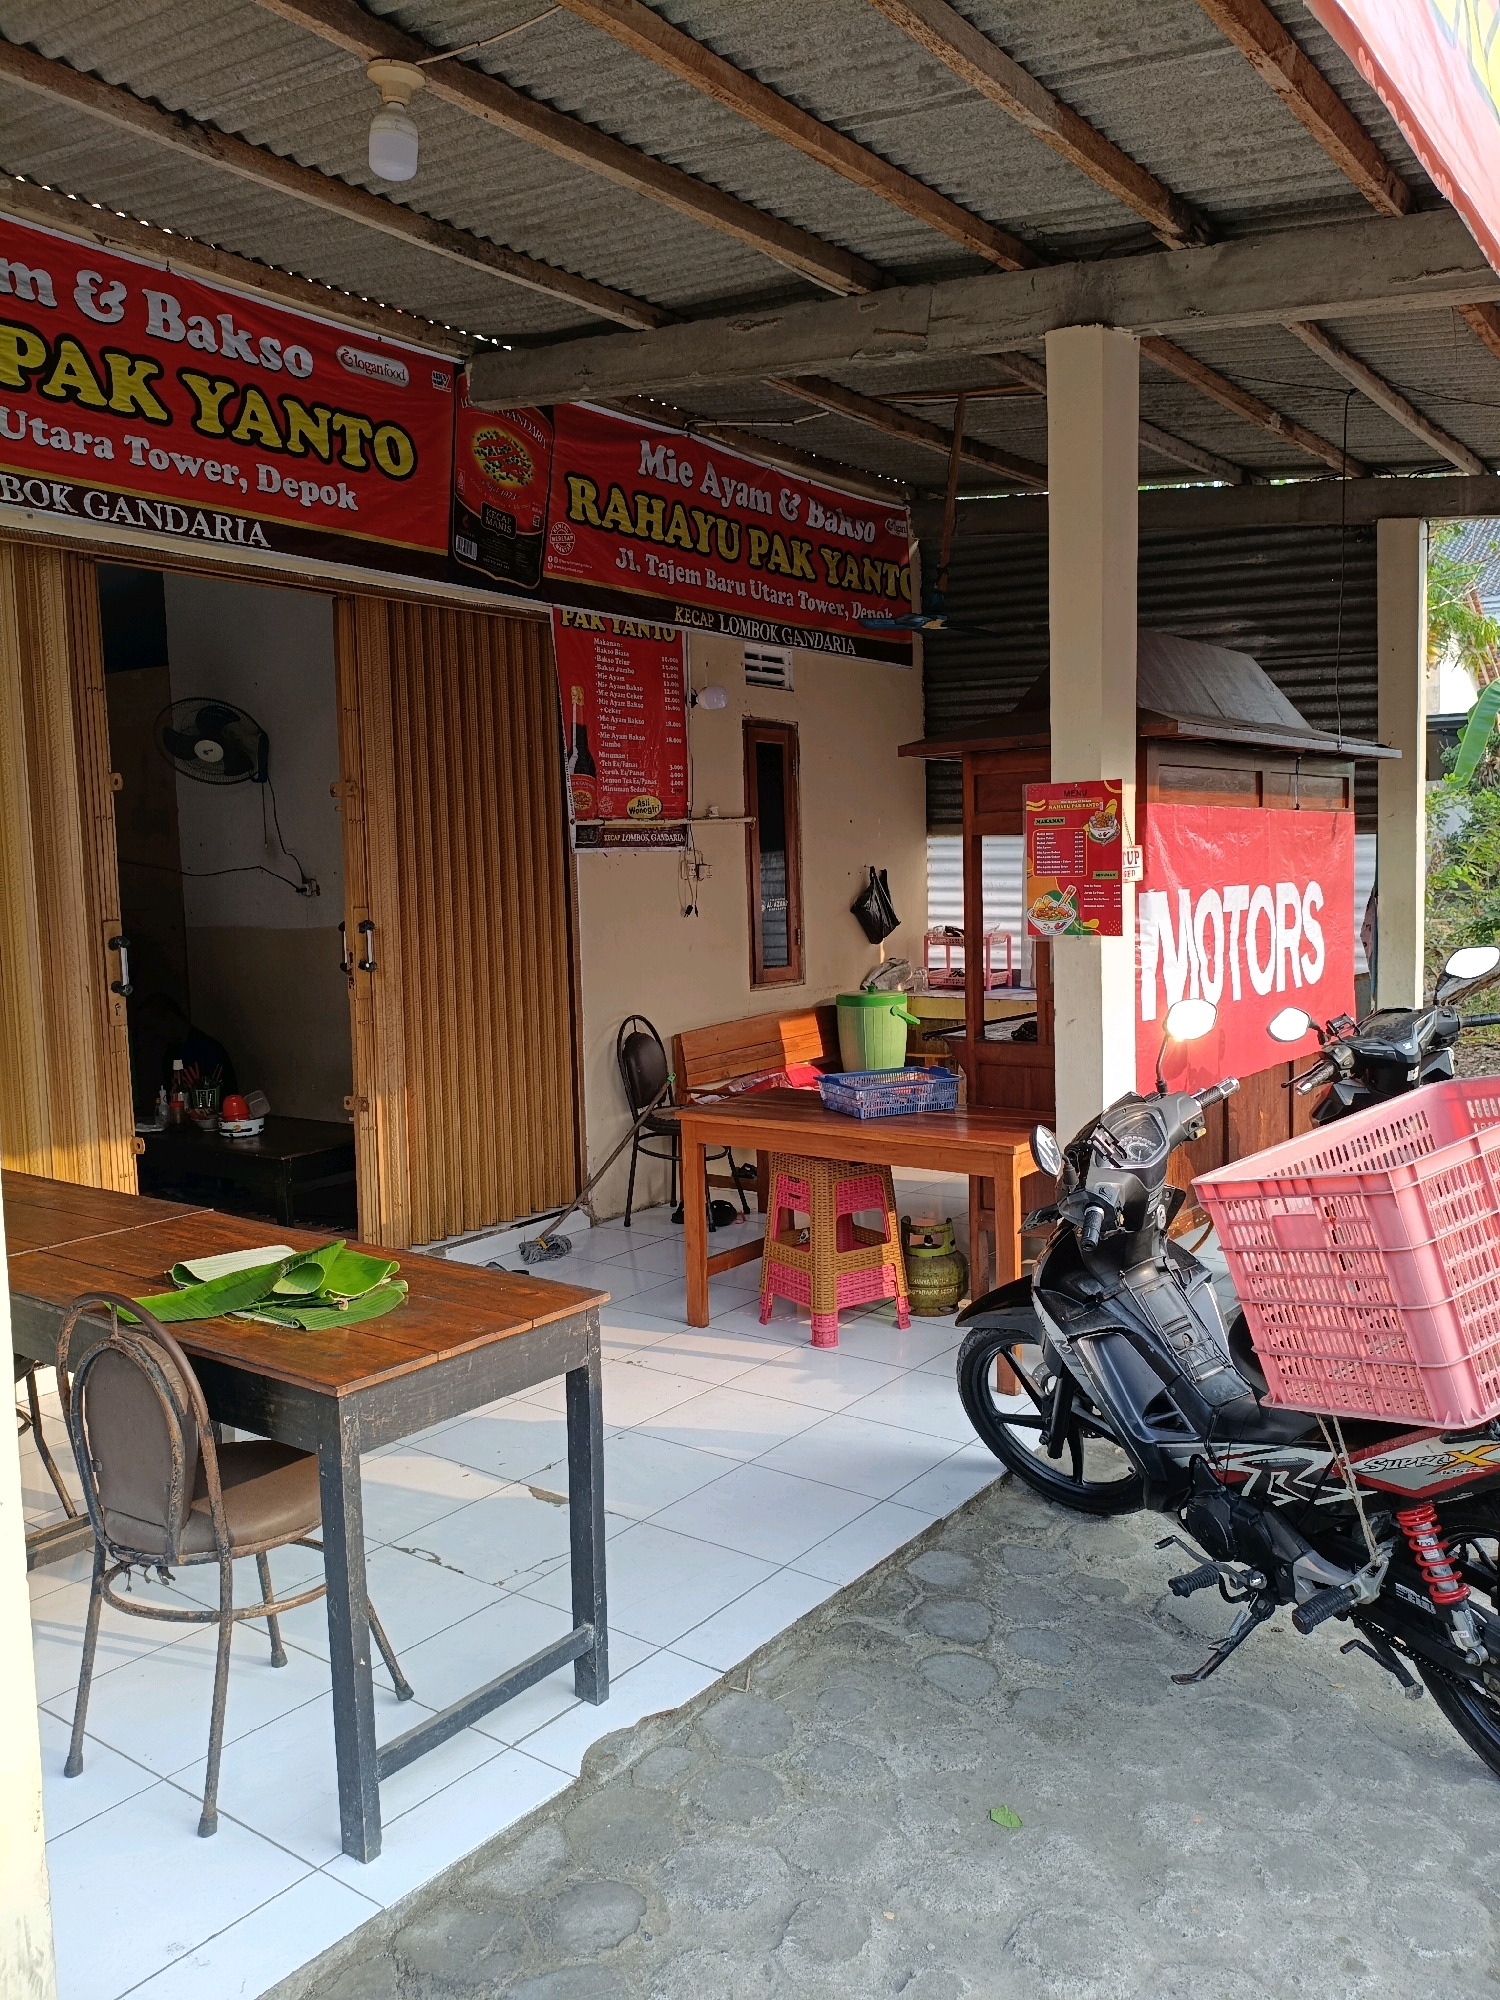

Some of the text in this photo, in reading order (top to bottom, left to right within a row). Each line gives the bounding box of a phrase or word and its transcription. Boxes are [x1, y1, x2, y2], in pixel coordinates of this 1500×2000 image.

[74, 269, 127, 323] &
[142, 288, 313, 378] Bakso
[0, 324, 414, 477] PAK YANTO
[0, 406, 358, 511] Utara Tower, Depok
[638, 439, 875, 542] Mie Ayam & Bakso
[84, 490, 271, 547] GANDARIA
[486, 508, 512, 524] KECAP
[485, 517, 512, 534] MANIS
[566, 476, 740, 561] RAHAYU
[748, 529, 816, 581] PAK
[820, 547, 911, 600] YANTO
[645, 553, 701, 588] Tajem
[705, 566, 747, 597] Baru
[750, 579, 794, 609] Utara
[798, 590, 849, 621] Tower,
[674, 605, 857, 656] KECAP LOMBOK GANDARIA
[597, 672, 607, 680] Mie
[615, 666, 635, 674] Jumbo
[608, 682, 625, 690] Ayam
[609, 691, 625, 699] Ayam
[610, 699, 626, 707] Ayam
[610, 716, 626, 724] Ayam
[627, 717, 644, 725] Bakso
[1063, 789, 1087, 797] MENU
[628, 804, 660, 815] Wonogiri
[637, 798, 650, 807] Asli
[650, 834, 685, 842] GANDARIA
[1139, 881, 1325, 1022] MOTORS
